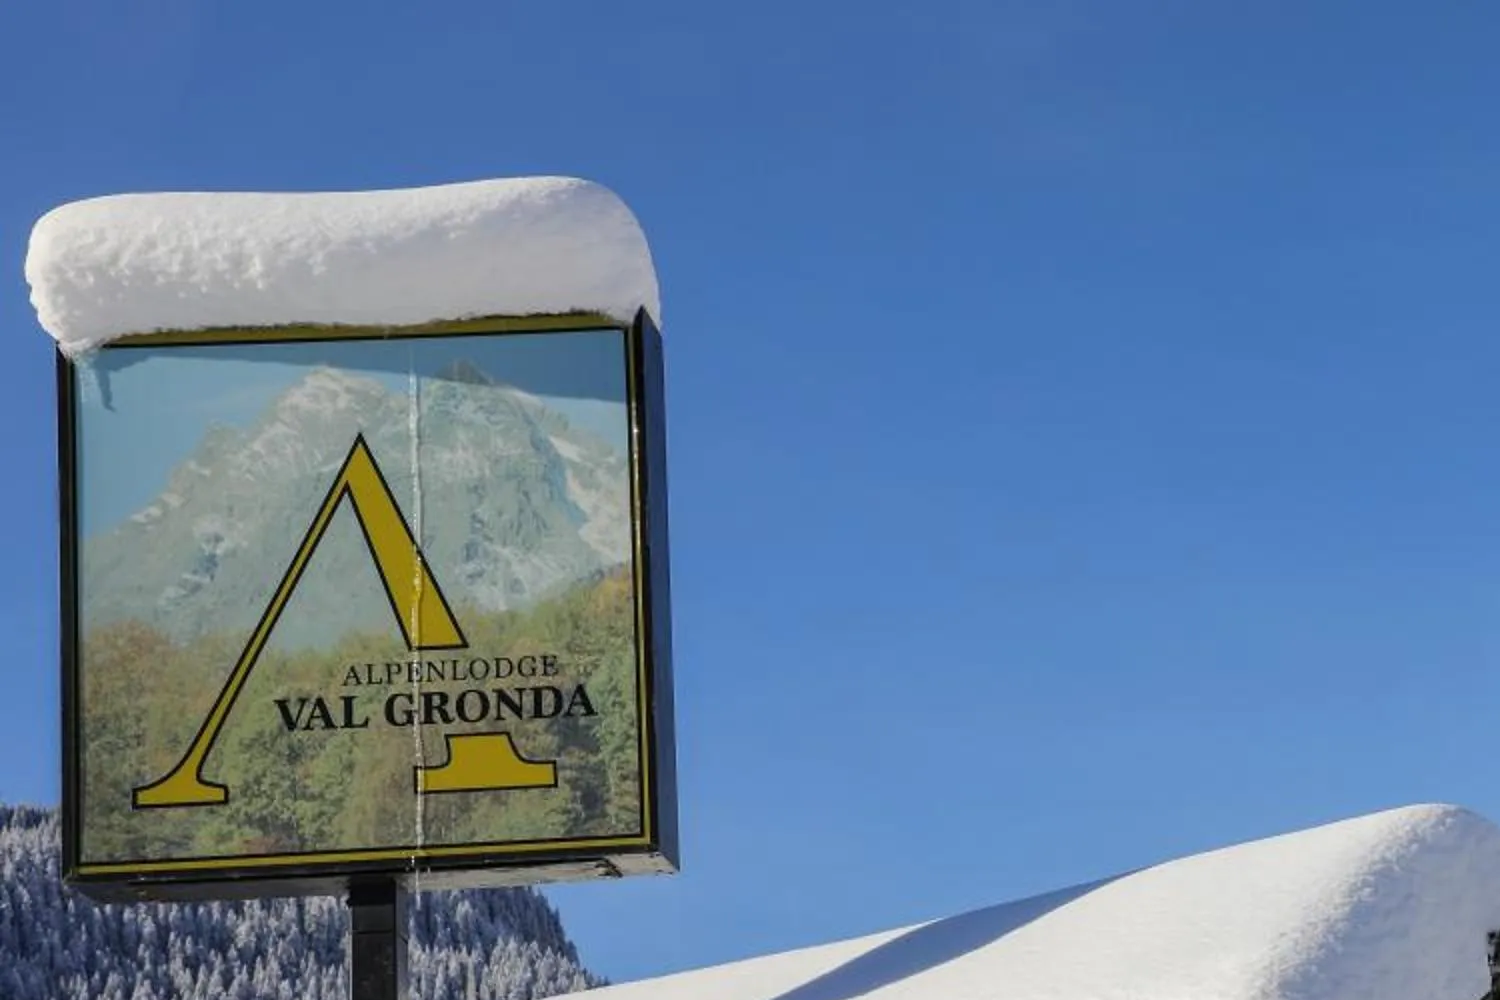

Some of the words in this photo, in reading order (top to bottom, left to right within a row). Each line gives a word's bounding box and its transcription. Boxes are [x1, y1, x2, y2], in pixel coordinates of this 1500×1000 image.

[340, 655, 560, 687] ALPENLODGE
[273, 694, 370, 732] VAL
[384, 683, 599, 727] GRONDA
